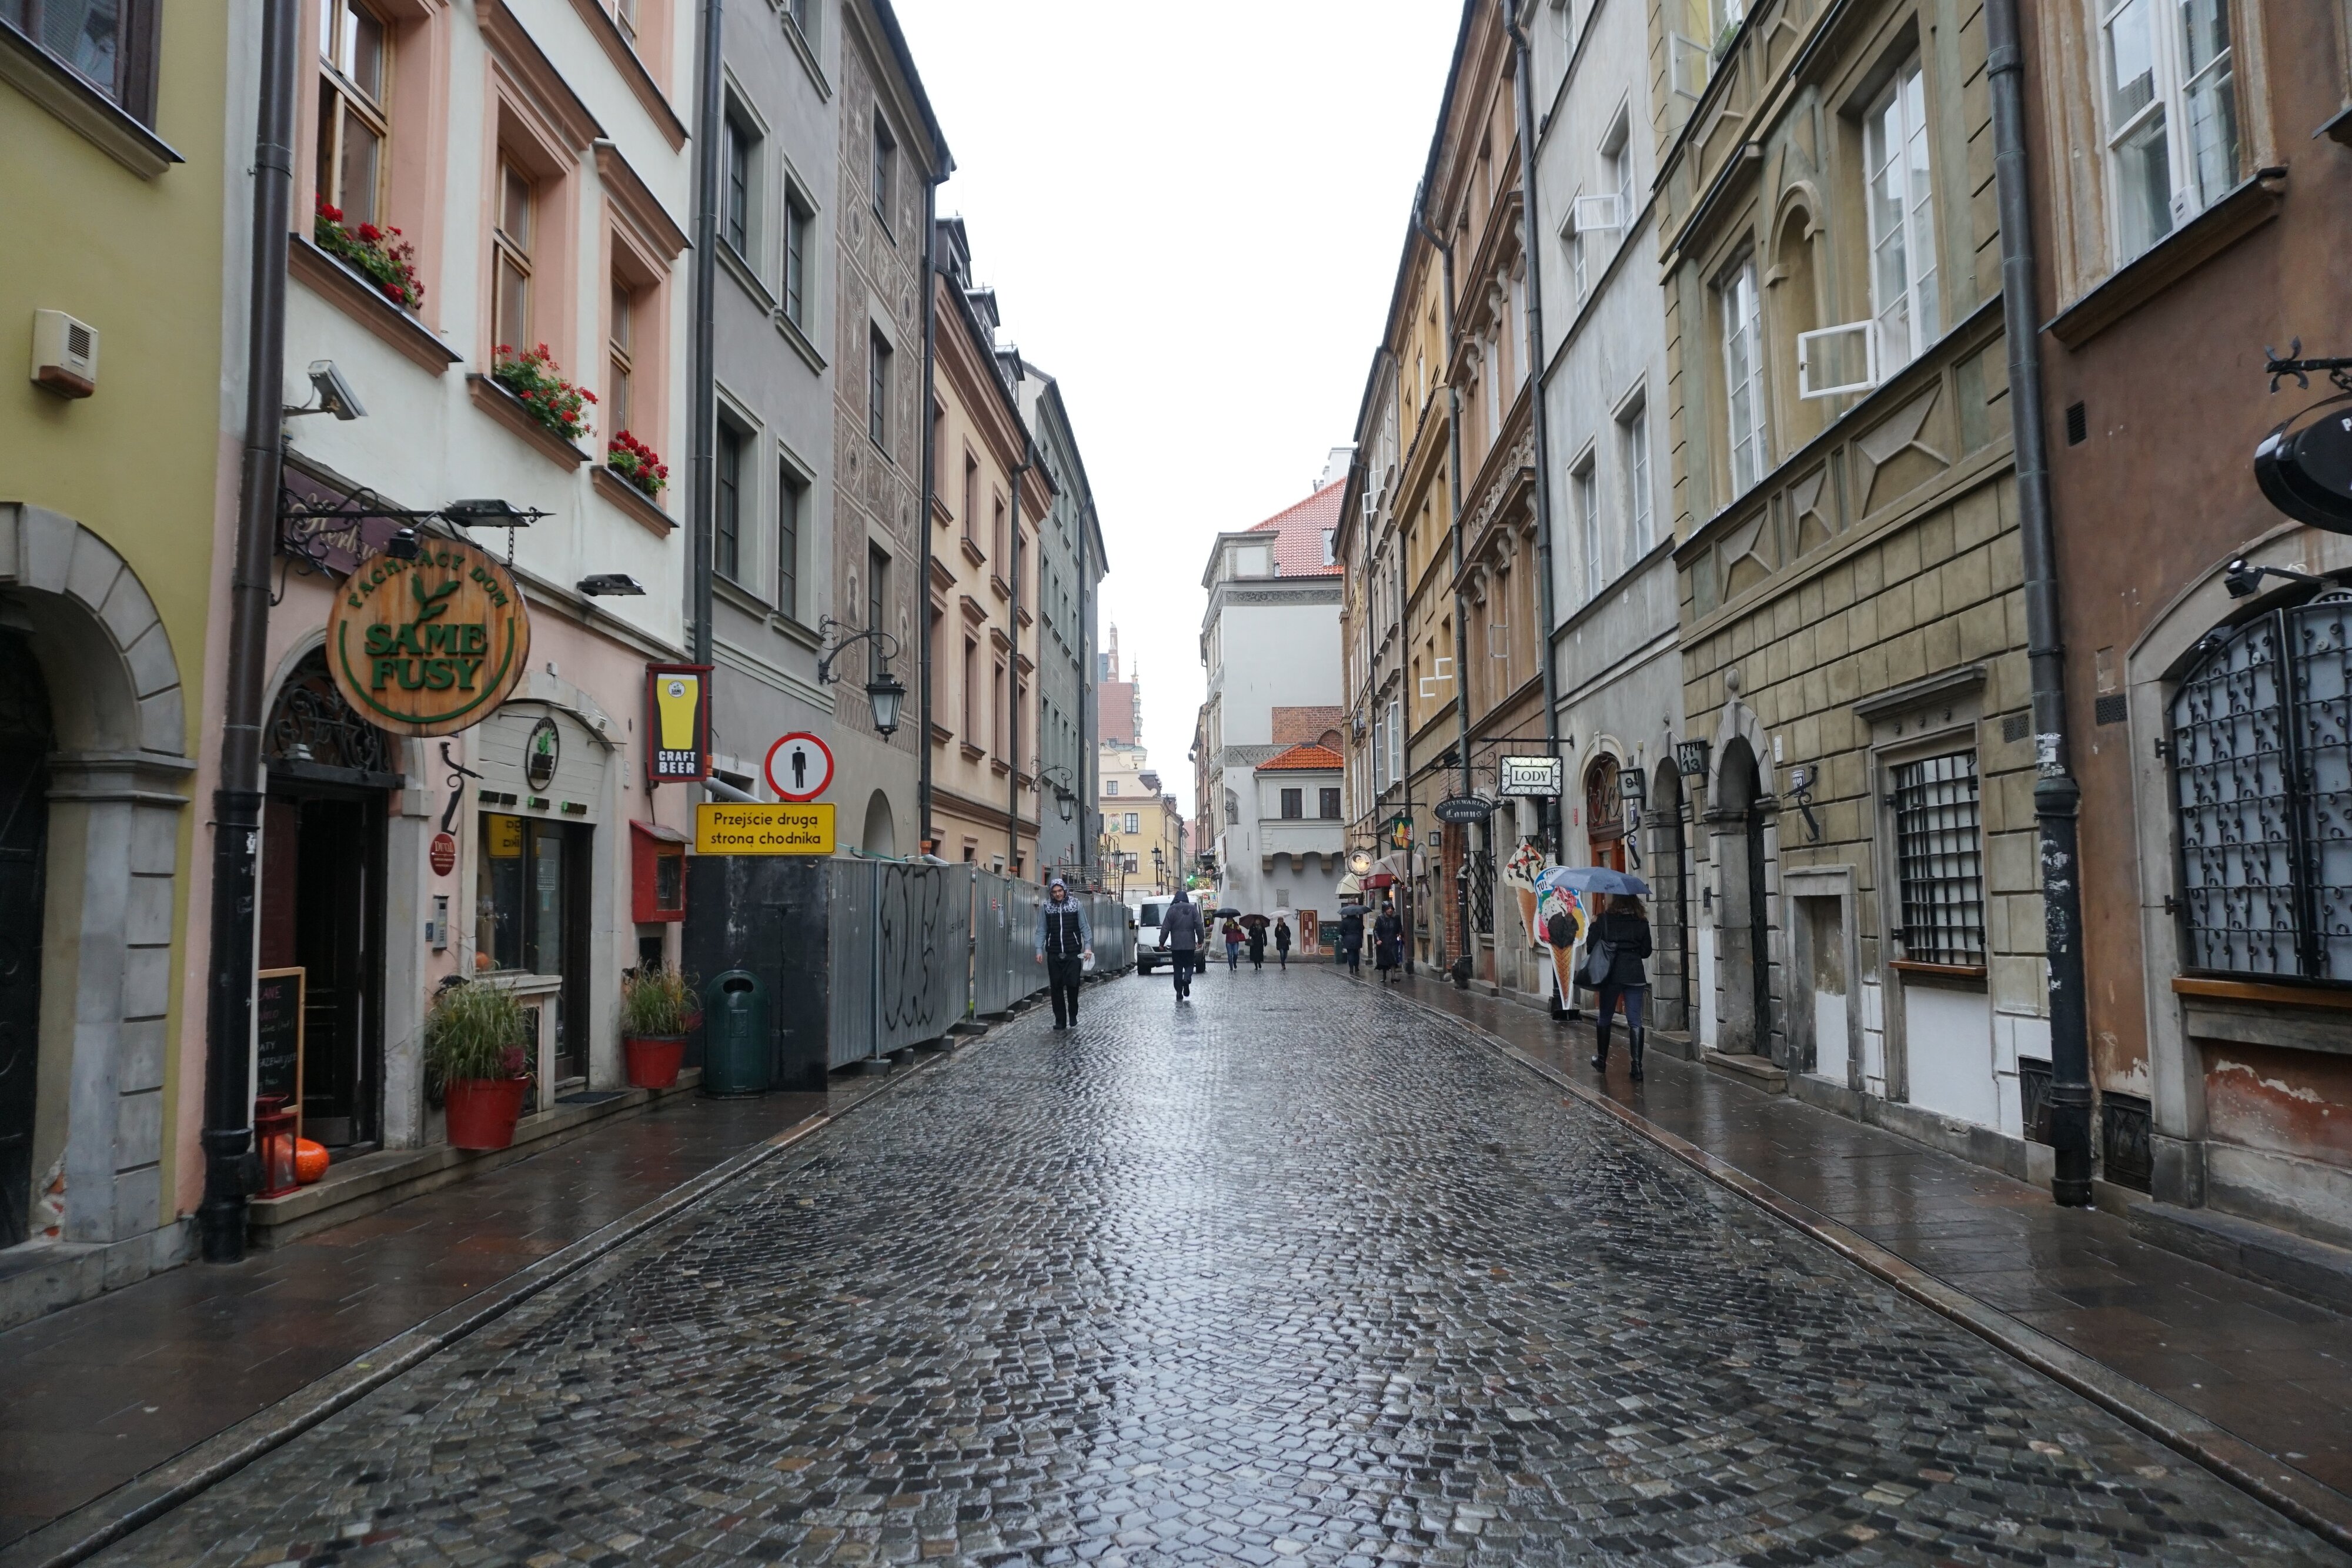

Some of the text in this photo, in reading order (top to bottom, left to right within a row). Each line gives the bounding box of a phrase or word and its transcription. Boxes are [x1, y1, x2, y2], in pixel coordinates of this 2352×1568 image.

[470, 566, 509, 609] DOM
[365, 623, 487, 655] SAME
[372, 658, 483, 690] FUSY
[659, 751, 696, 761] CRAFT
[659, 761, 694, 774] BEER
[1683, 758, 1700, 771] 13
[1515, 770, 1548, 781] LODY
[1625, 777, 1633, 788] 9
[1438, 800, 1489, 810] ANTYKWARIAT
[1446, 808, 1482, 818] Lamus
[714, 812, 818, 829] Przejście drugą
[711, 831, 821, 847] stroną chodnika
[1537, 881, 1548, 892] TU!
